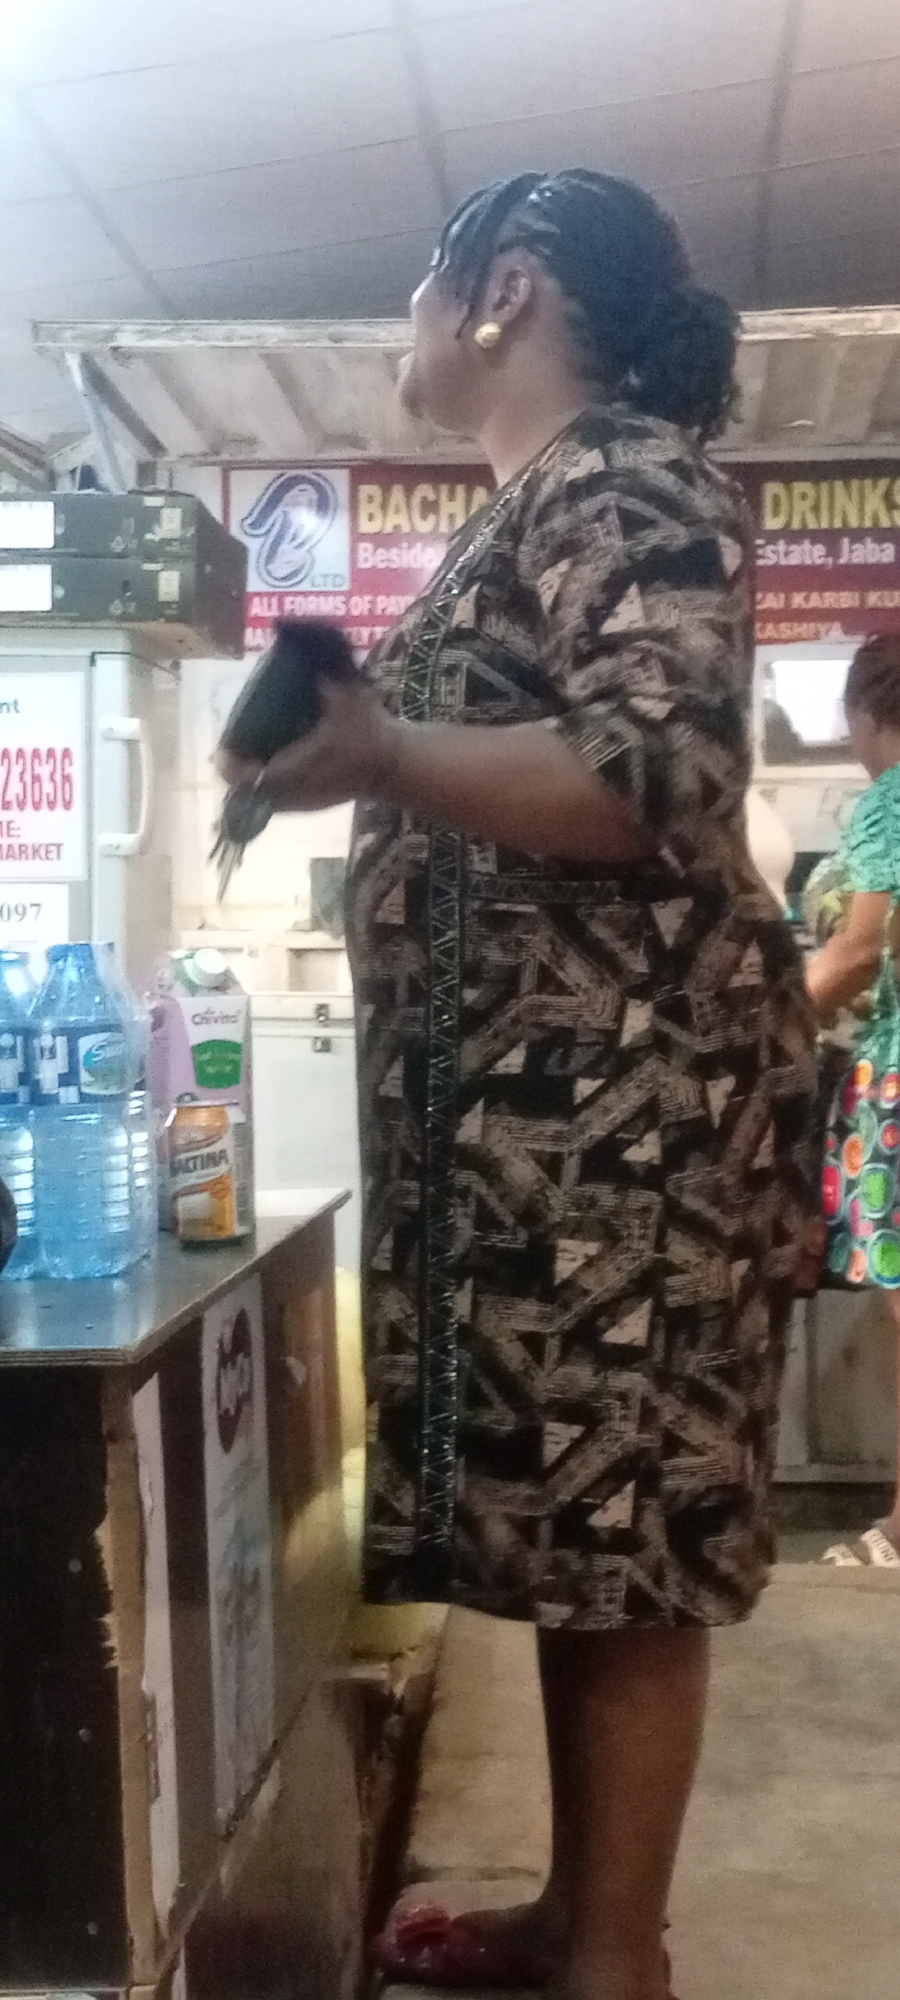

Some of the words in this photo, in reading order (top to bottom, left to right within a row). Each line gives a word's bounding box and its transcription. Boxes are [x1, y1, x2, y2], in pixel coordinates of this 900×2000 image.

[838, 536, 896, 565] Jaba
[310, 573, 346, 588] LTD
[250, 596, 279, 617] ALL
[350, 594, 374, 616] OF
[1, 747, 73, 811] 23636
[0, 902, 42, 923] 097
